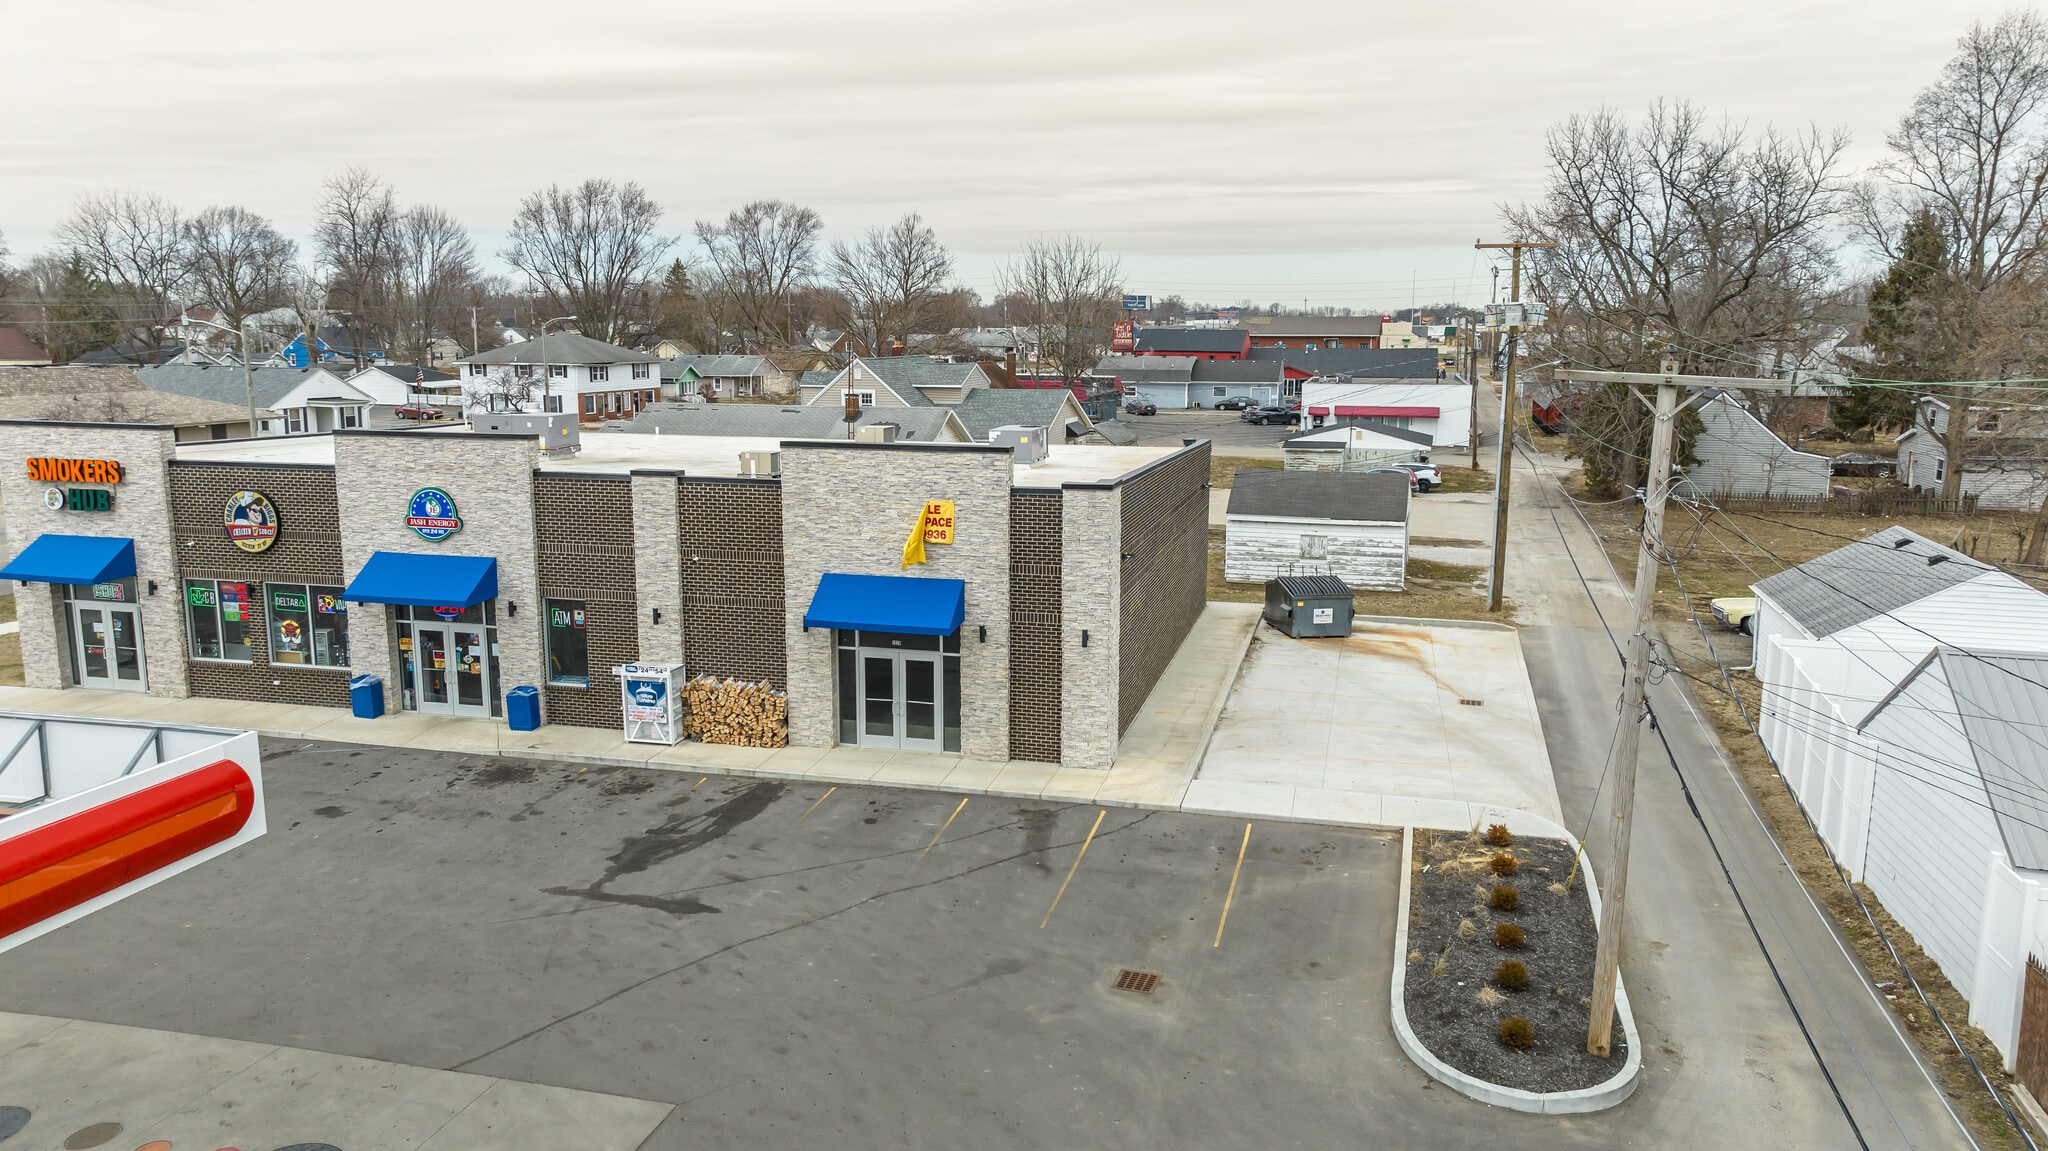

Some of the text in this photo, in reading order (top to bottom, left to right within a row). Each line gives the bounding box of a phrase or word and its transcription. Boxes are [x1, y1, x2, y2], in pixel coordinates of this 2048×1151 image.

[26, 457, 121, 484] SMOKERS
[68, 488, 111, 512] HUB
[225, 495, 239, 523] CHARLEY
[410, 518, 456, 527] JASH ENERGY
[924, 517, 953, 528] PACE
[554, 610, 571, 626] ATM
